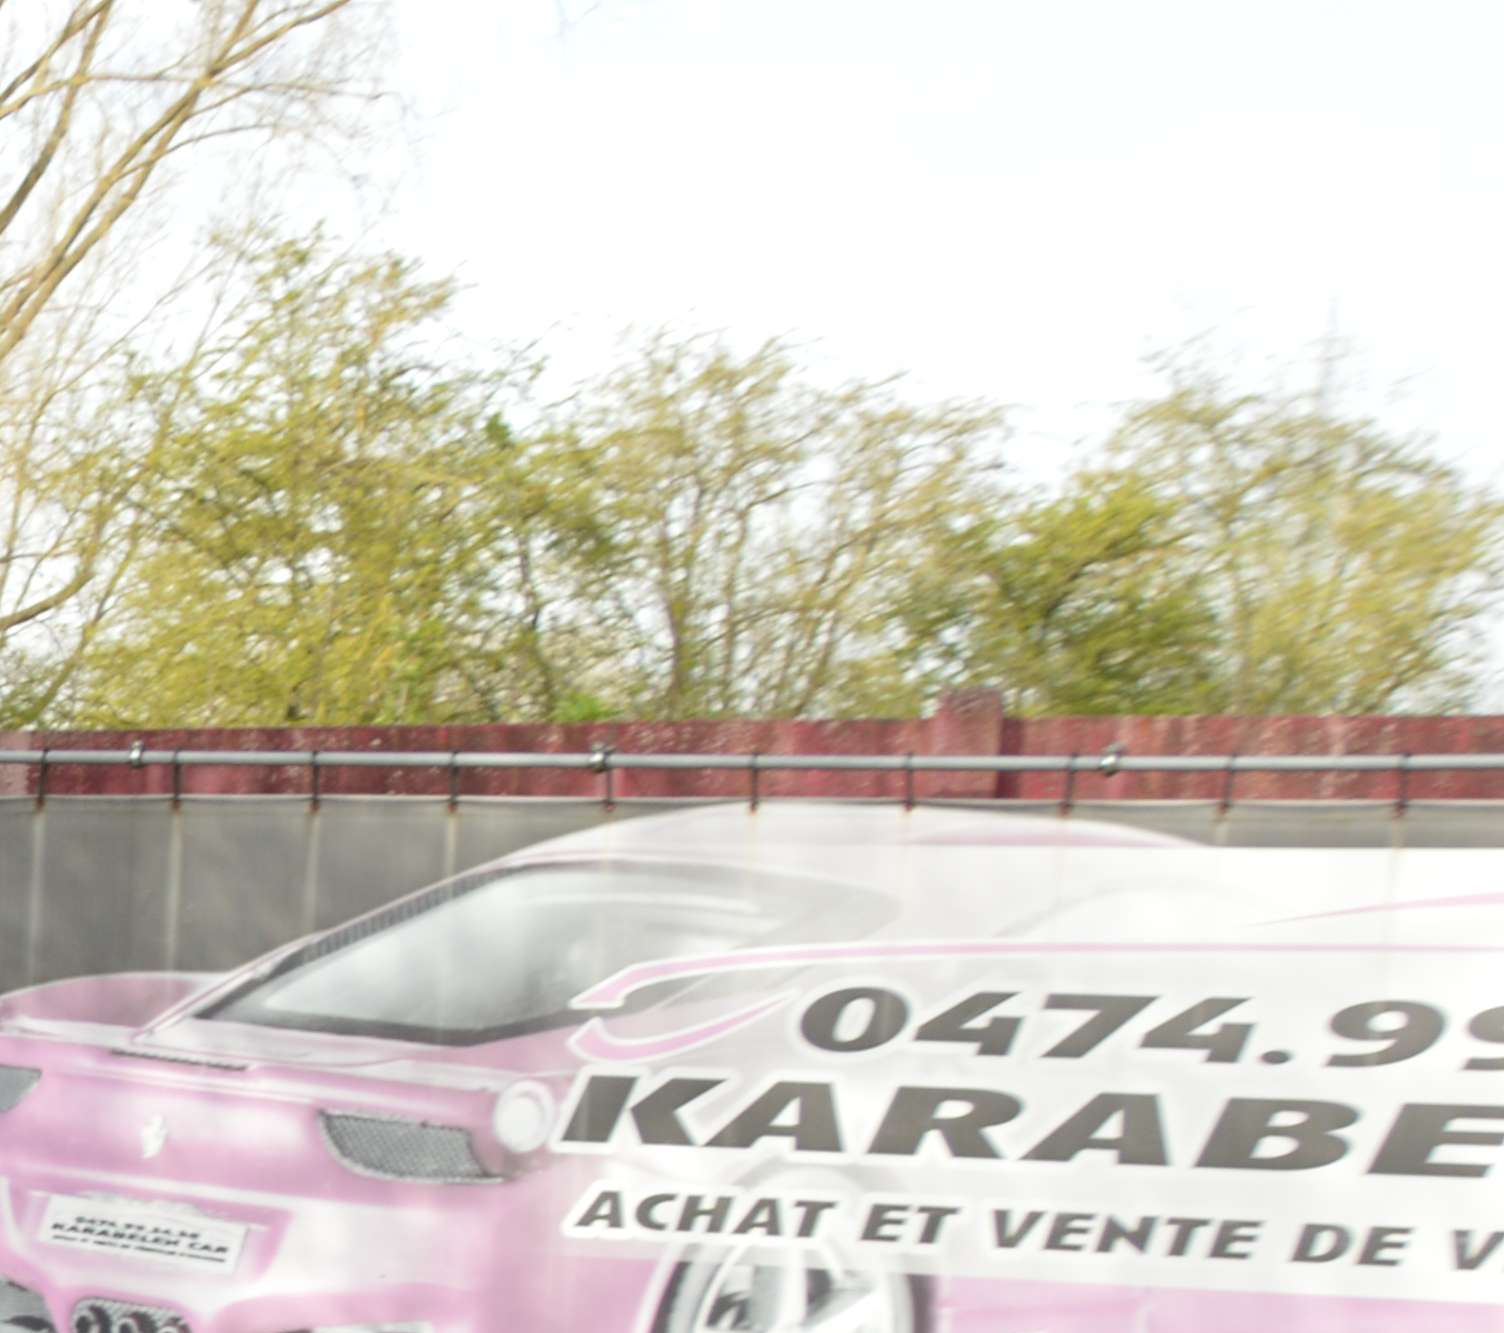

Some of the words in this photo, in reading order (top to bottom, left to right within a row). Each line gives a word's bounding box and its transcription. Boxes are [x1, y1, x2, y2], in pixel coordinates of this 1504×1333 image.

[560, 1074, 1504, 1179] KARABE
[574, 1190, 836, 1239] ACHAT
[858, 1203, 960, 1245] ET
[992, 1208, 1266, 1260] VENTE
[1291, 1222, 1415, 1267] DE
